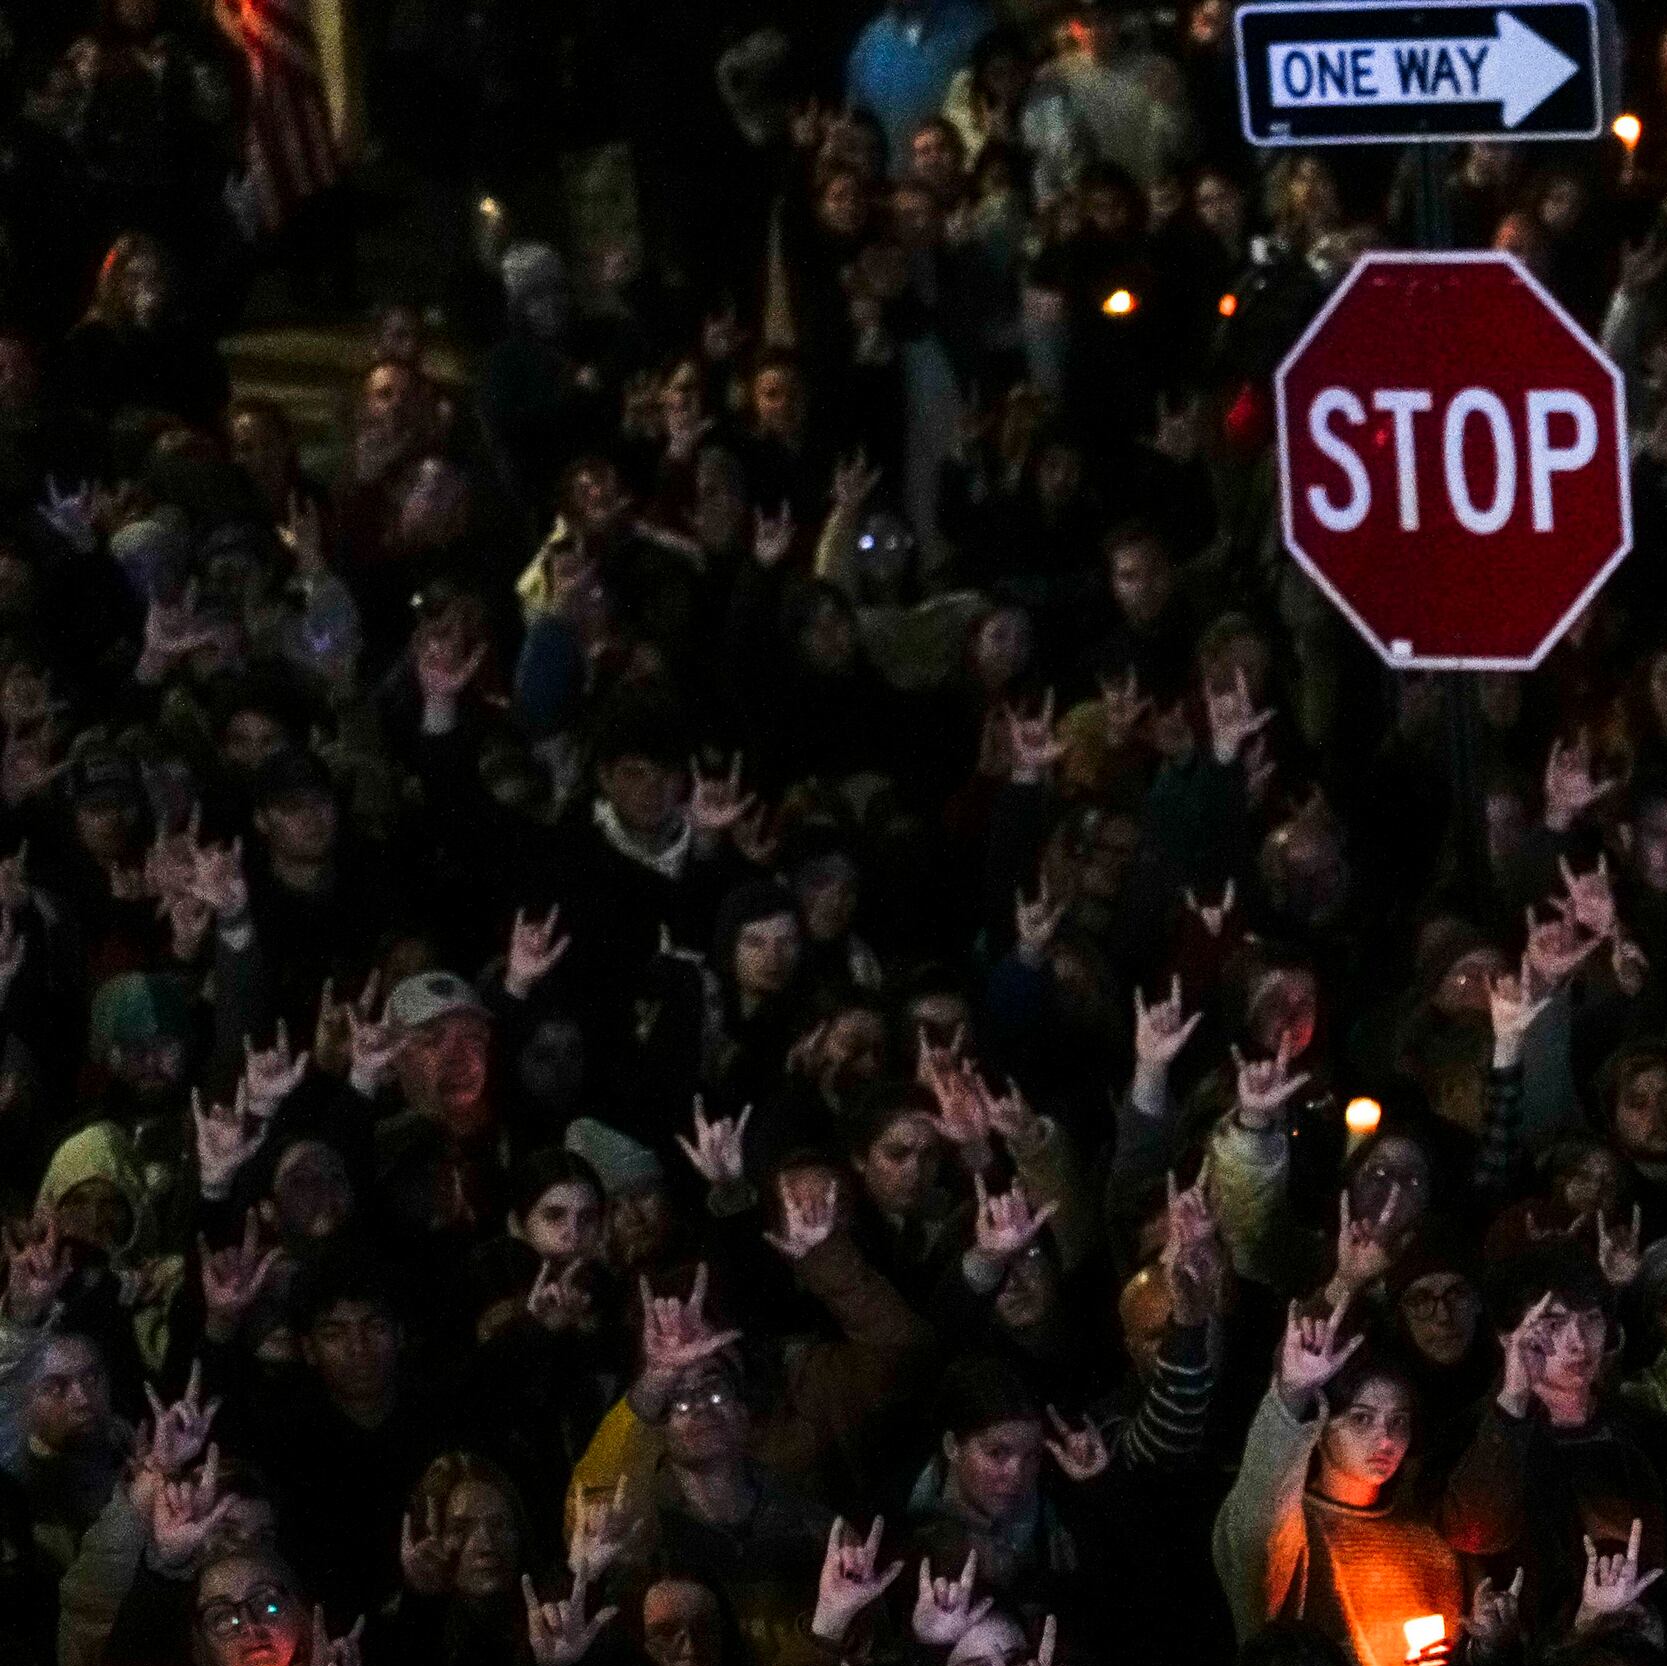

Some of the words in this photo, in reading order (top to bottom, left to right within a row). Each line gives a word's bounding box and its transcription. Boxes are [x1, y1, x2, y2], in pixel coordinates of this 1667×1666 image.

[1282, 49, 1378, 97] ONE
[1394, 46, 1490, 96] WAY
[1306, 386, 1598, 534] STOP
